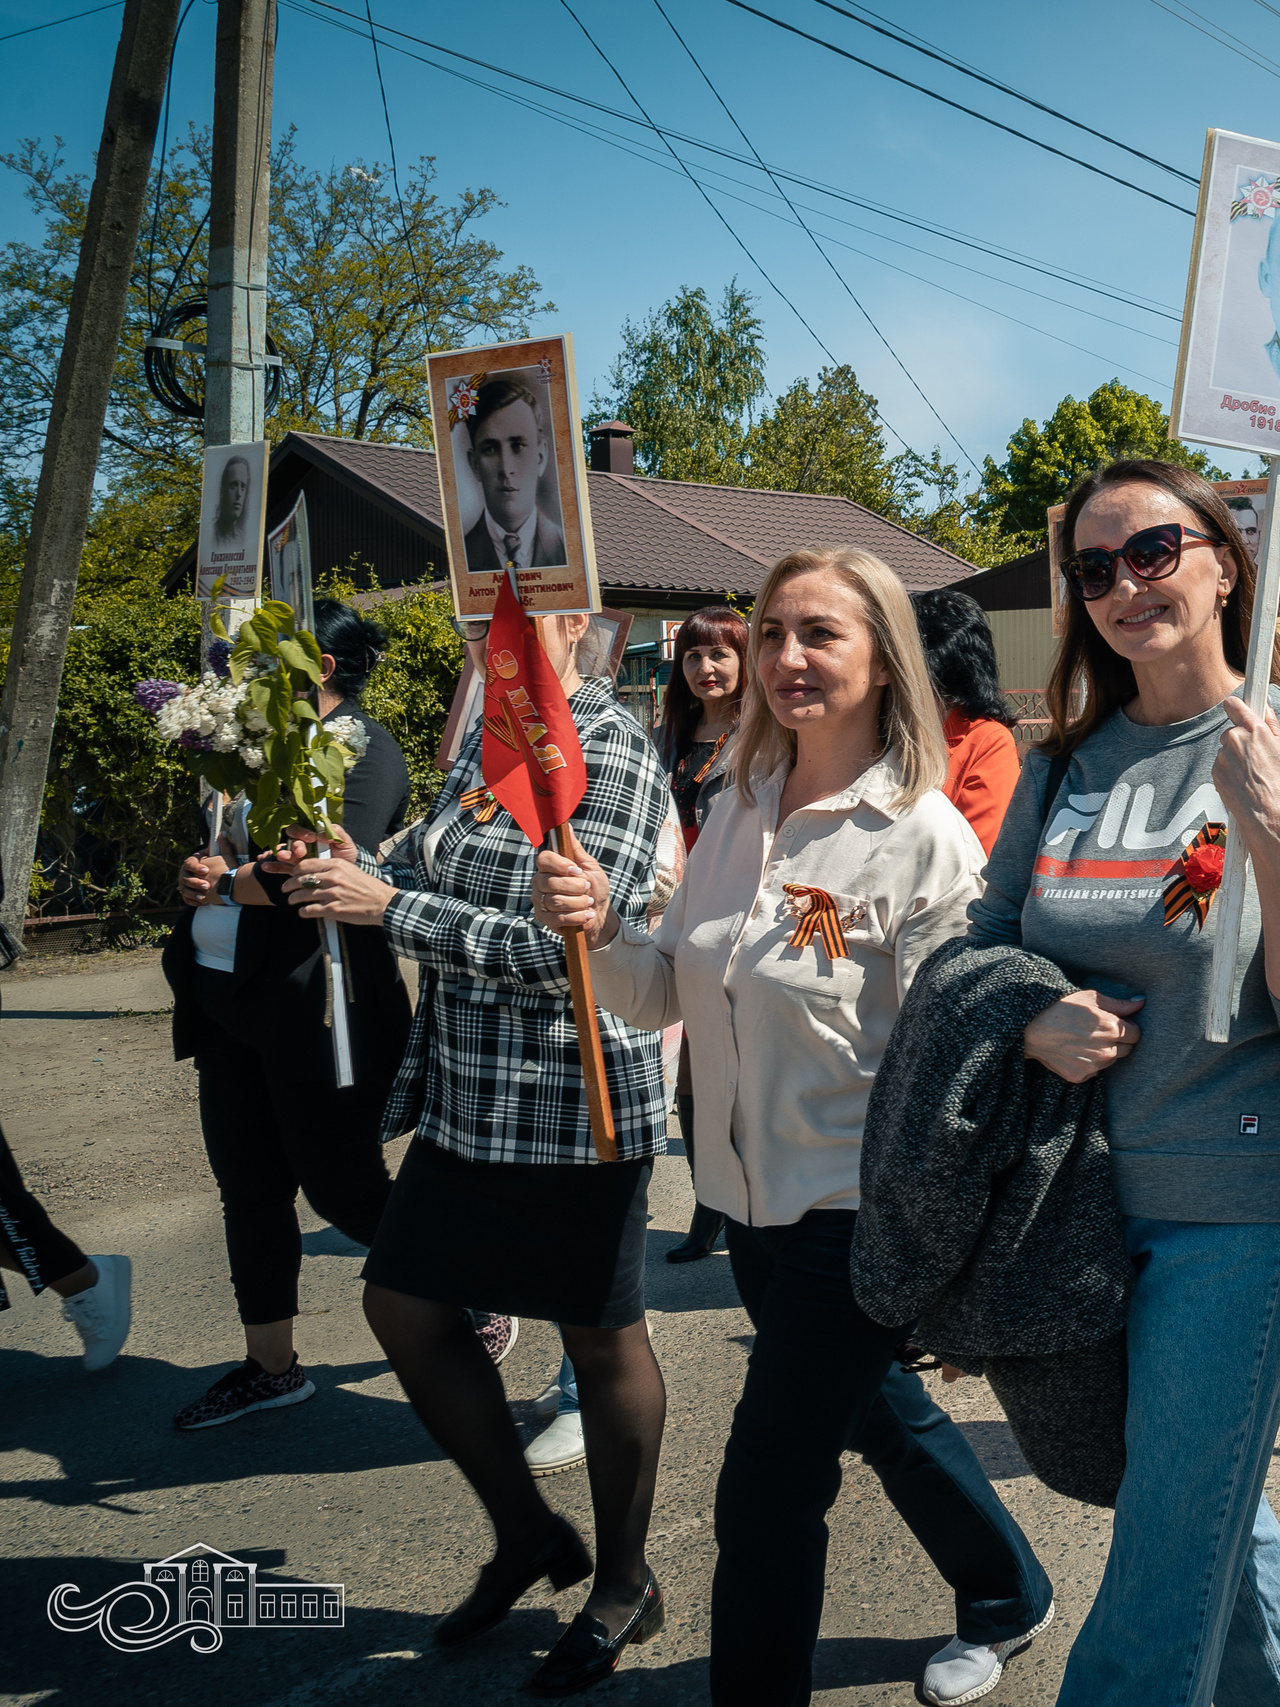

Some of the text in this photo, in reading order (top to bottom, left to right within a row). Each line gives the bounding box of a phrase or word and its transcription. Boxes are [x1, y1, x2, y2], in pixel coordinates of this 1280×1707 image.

[1220, 394, 1276, 416] Дробис
[468, 586, 497, 598] Антон
[505, 686, 567, 774] МАЯ
[1043, 888, 1090, 900] ITALIAN
[1091, 888, 1164, 900] SPORTSWEA
